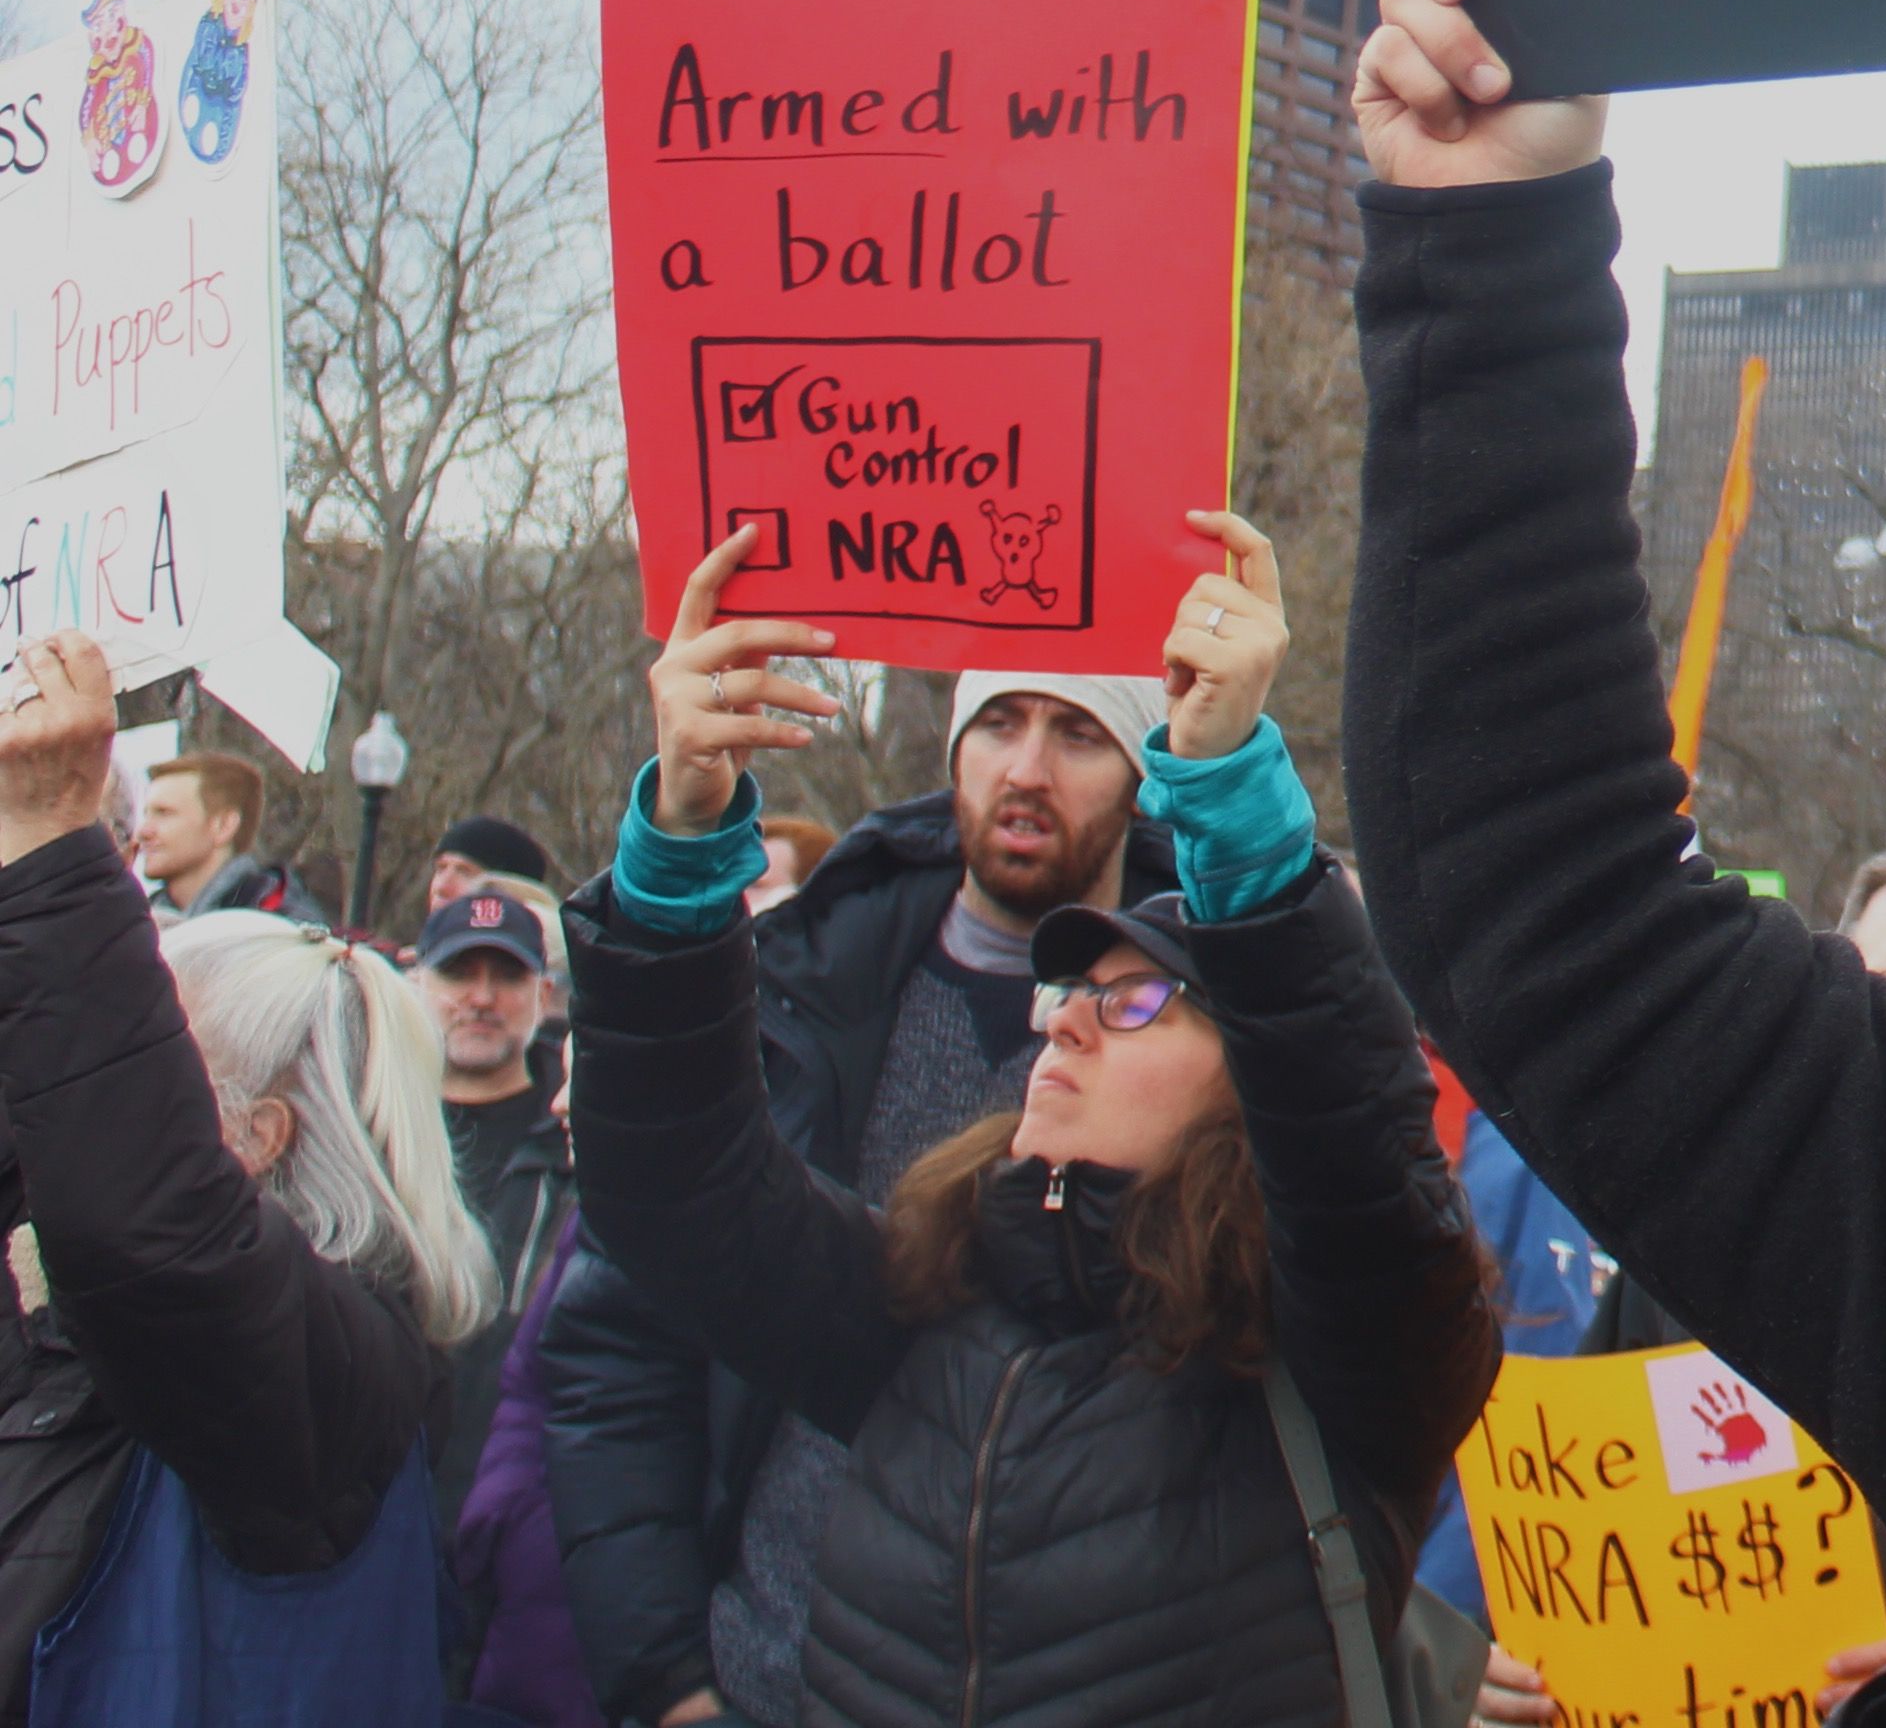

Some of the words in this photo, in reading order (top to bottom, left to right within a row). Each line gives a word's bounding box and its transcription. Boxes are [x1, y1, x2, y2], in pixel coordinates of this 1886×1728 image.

[658, 43, 960, 152] Armed
[1008, 50, 1187, 140] with
[660, 238, 712, 291] a
[777, 188, 1070, 292] ballot
[51, 217, 231, 430] Puppets
[798, 376, 920, 434] Gun
[53, 491, 183, 629] NRA
[828, 511, 966, 586] NRA
[1492, 1514, 1650, 1629] NRA
[1677, 1663, 1828, 1728] tim
